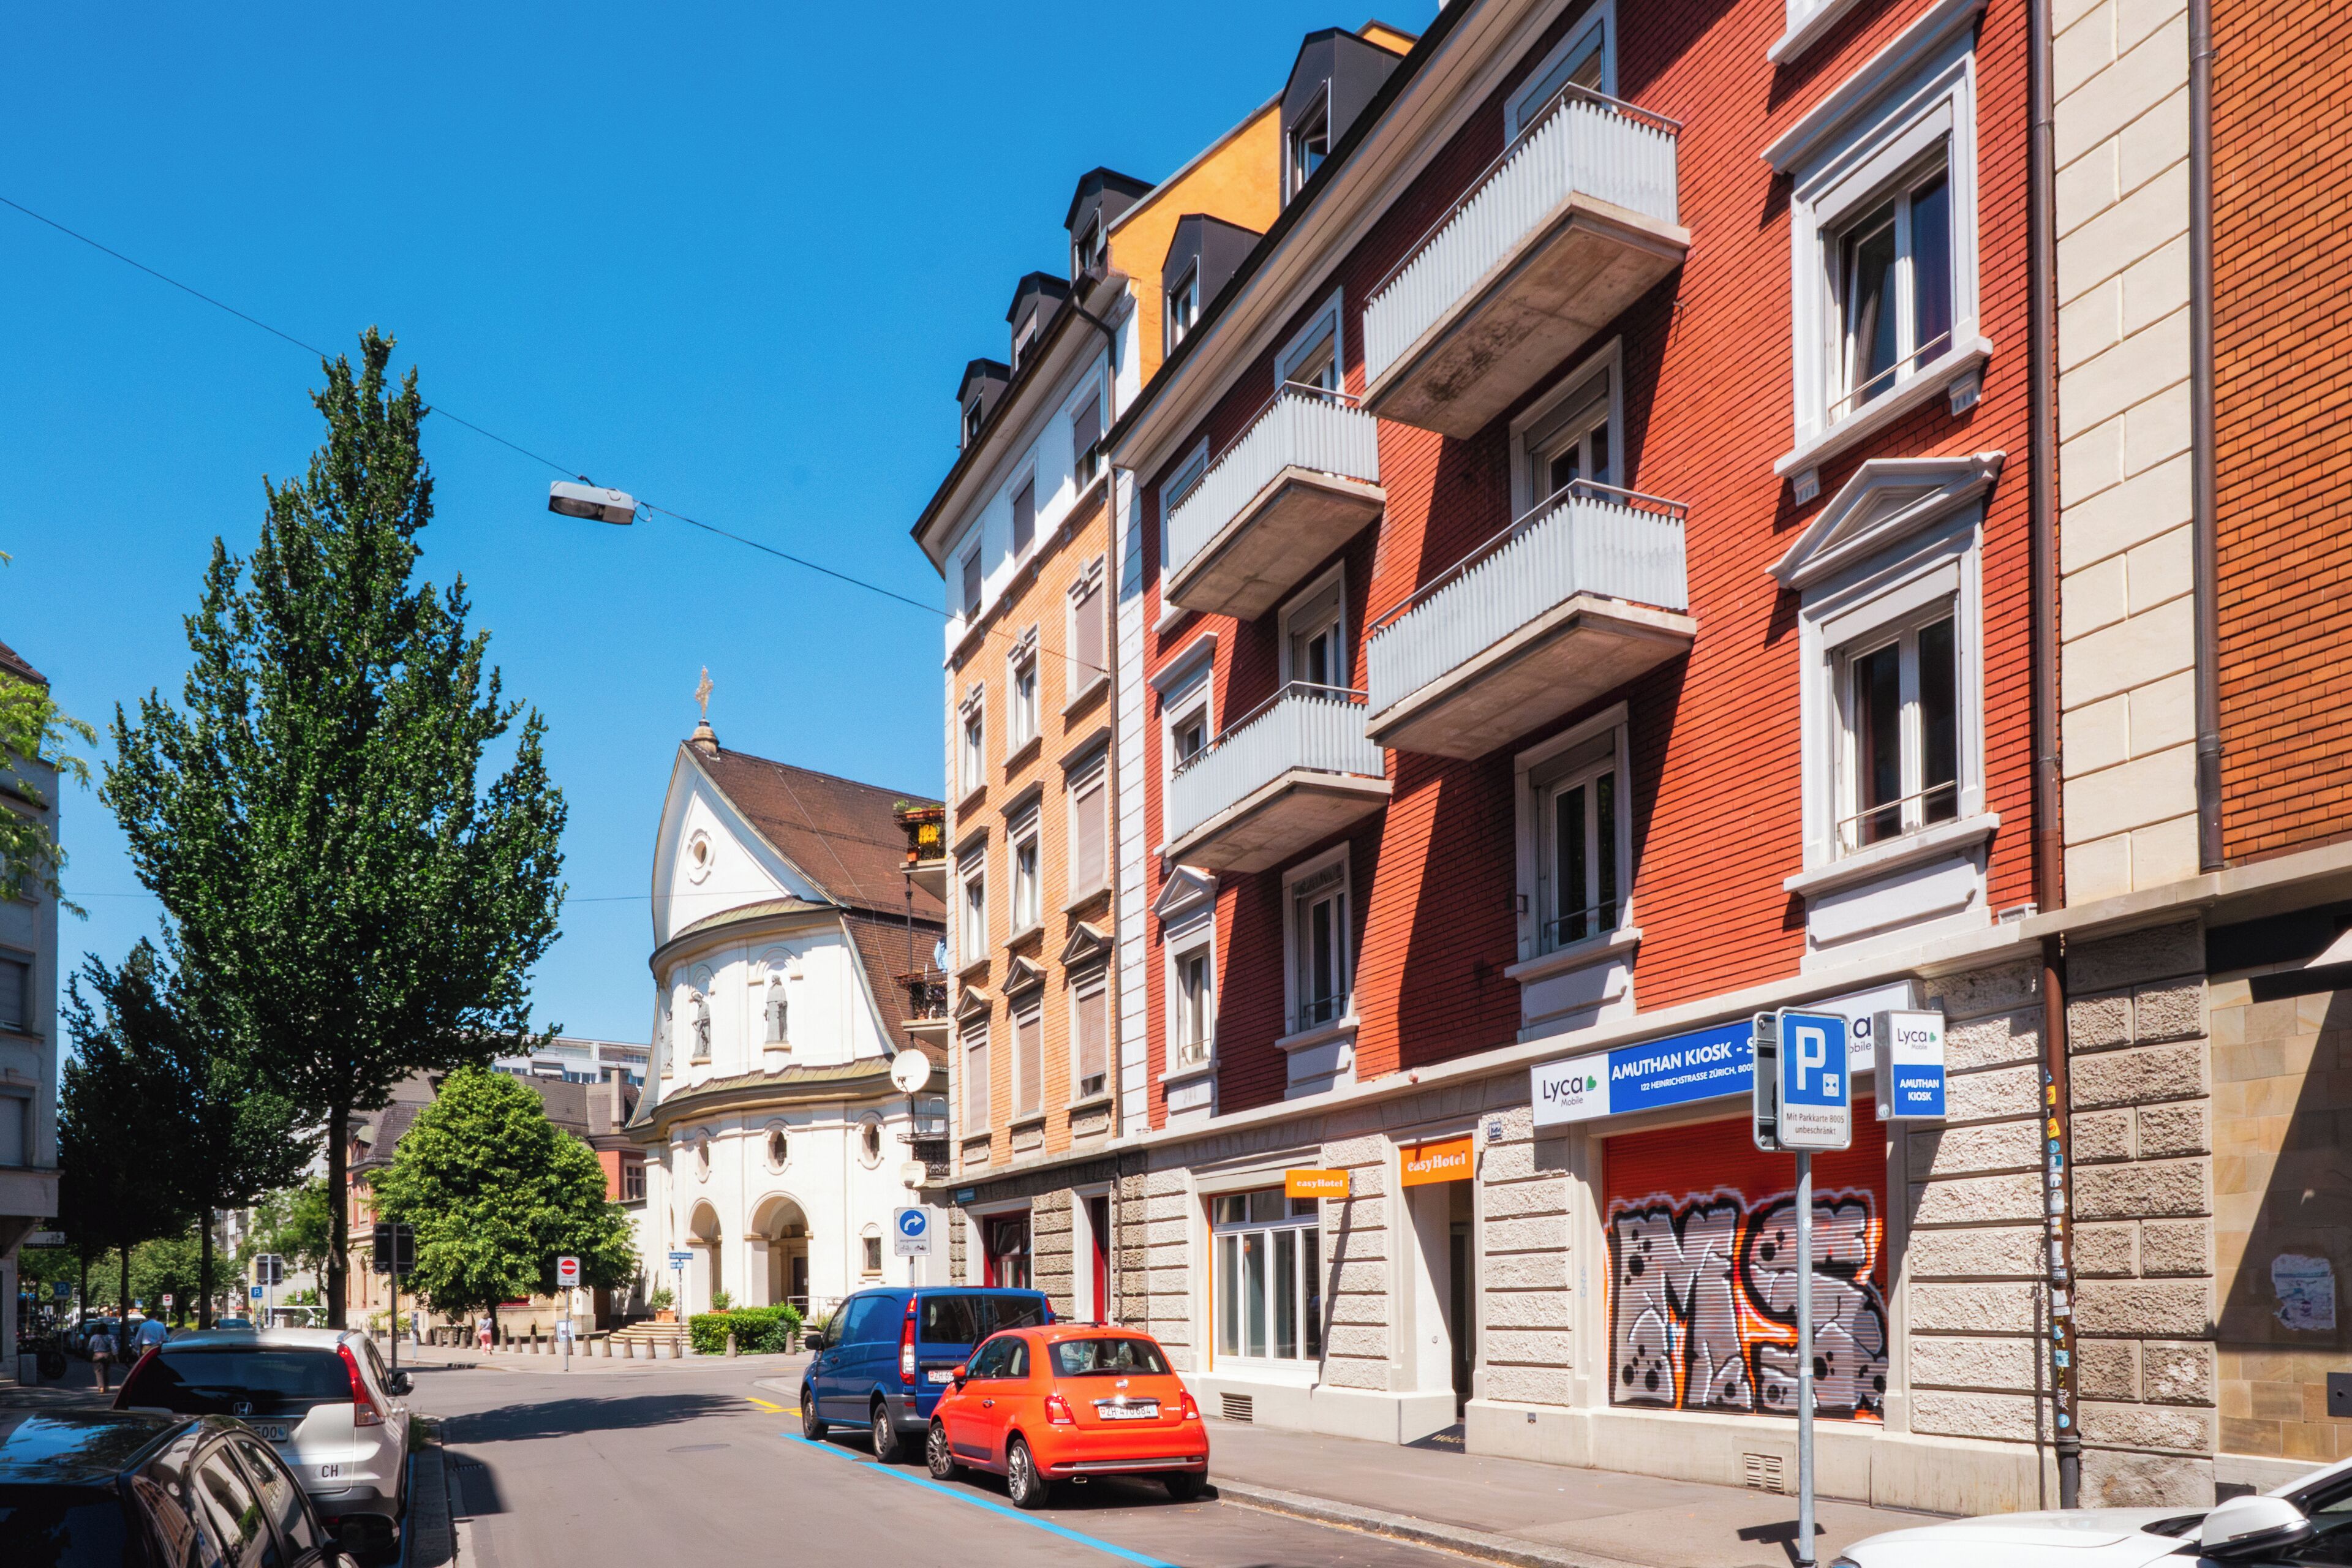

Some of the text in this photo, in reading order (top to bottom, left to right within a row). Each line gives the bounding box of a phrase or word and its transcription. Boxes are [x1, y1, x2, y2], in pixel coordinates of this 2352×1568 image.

[1898, 1028, 1927, 1045] Lyca
[1850, 1042, 1872, 1054] obile
[1611, 1052, 1681, 1080] AMUTHAN
[1686, 1041, 1733, 1066] KIOSK
[1796, 1026, 1826, 1090] P
[1651, 1073, 1707, 1089] HEINRICHSTRASSE
[1709, 1066, 1736, 1079] ZÜRICH,
[1900, 1079, 1939, 1088] AMUTHAN
[1544, 1077, 1583, 1102] Lyca
[1908, 1091, 1932, 1101] KIOSK
[1561, 1096, 1583, 1107] Mobile
[1787, 1112, 1844, 1123] Mit Parkkarte 8005
[1489, 1123, 1501, 1136] 122
[1795, 1125, 1836, 1135] unbeschränkt
[1408, 1151, 1466, 1173] easyHotel
[1297, 1179, 1343, 1188] easyHotel
[322, 1465, 338, 1478] CH
